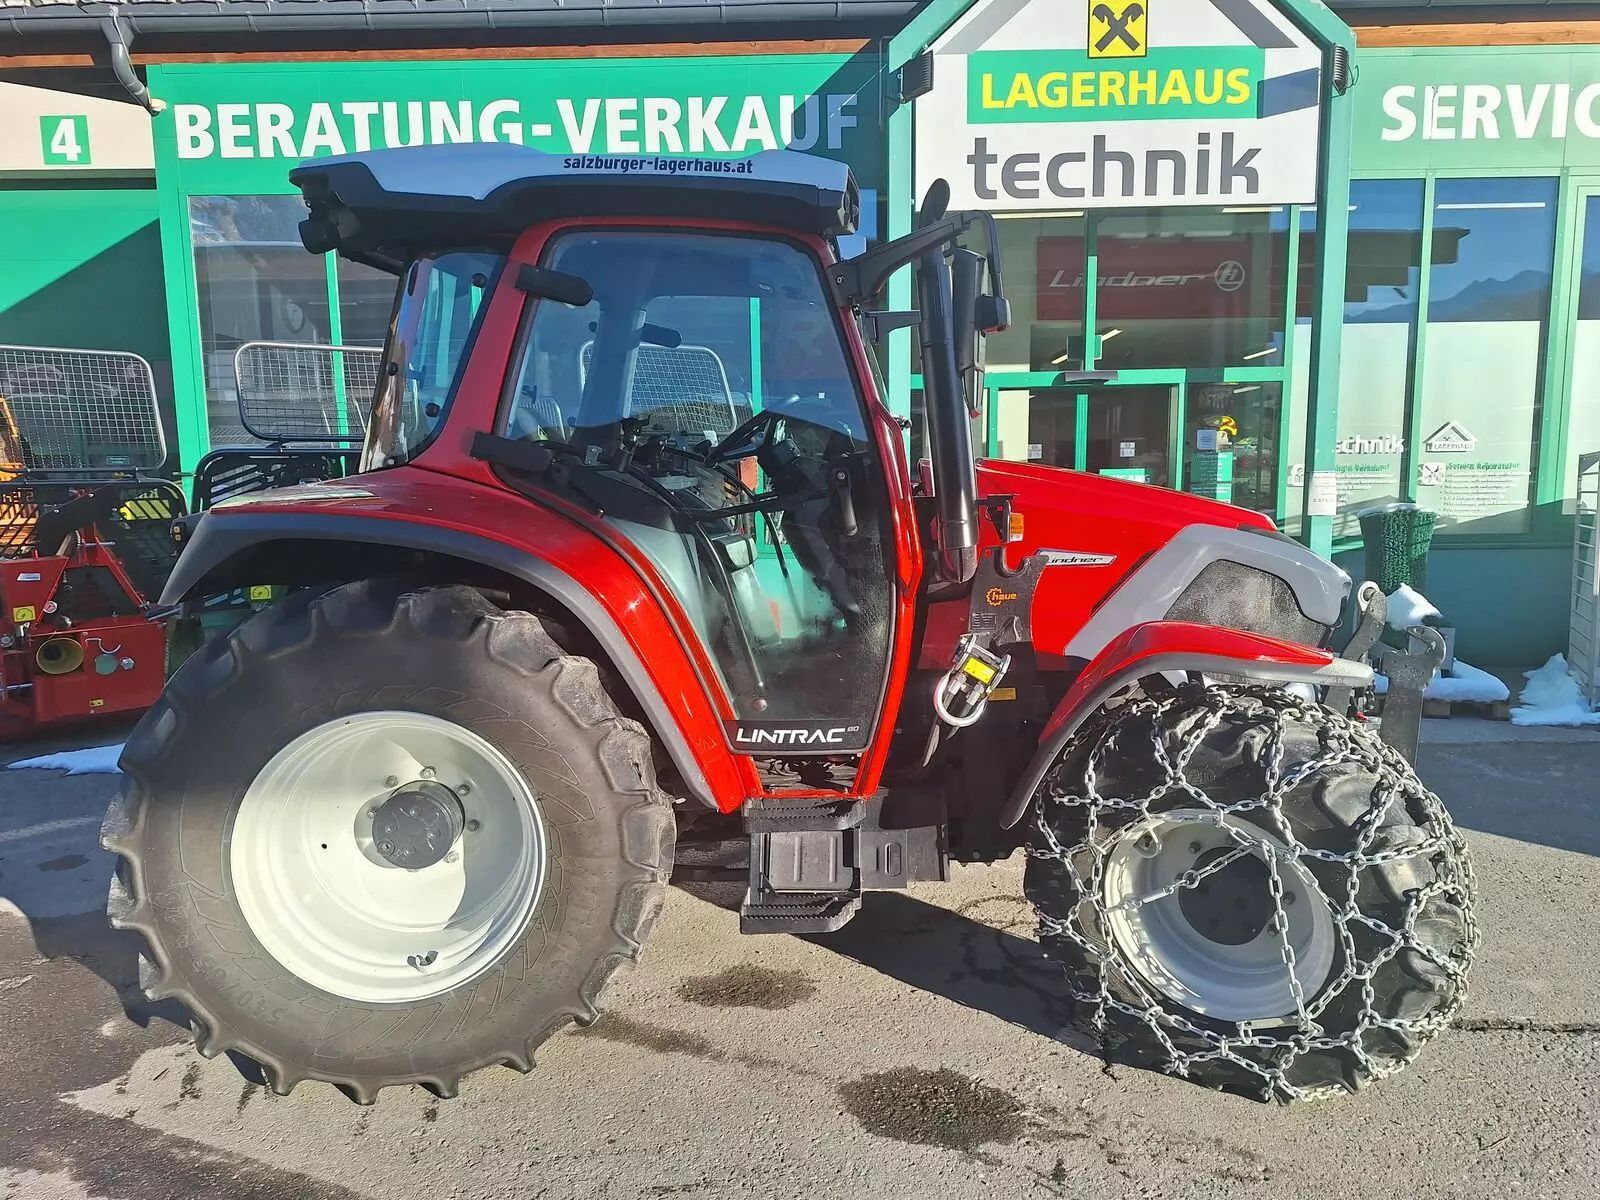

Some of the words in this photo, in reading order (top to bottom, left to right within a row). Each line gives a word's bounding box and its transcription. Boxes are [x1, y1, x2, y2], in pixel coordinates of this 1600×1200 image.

[981, 67, 1251, 109] LAGERHAUS
[50, 118, 82, 161] 4
[174, 94, 858, 160] BERATUNG-VERKAUF
[563, 155, 753, 174] salzburger-lagerhaus.at
[967, 132, 1262, 199] technik
[736, 728, 845, 744] LINTRAC
